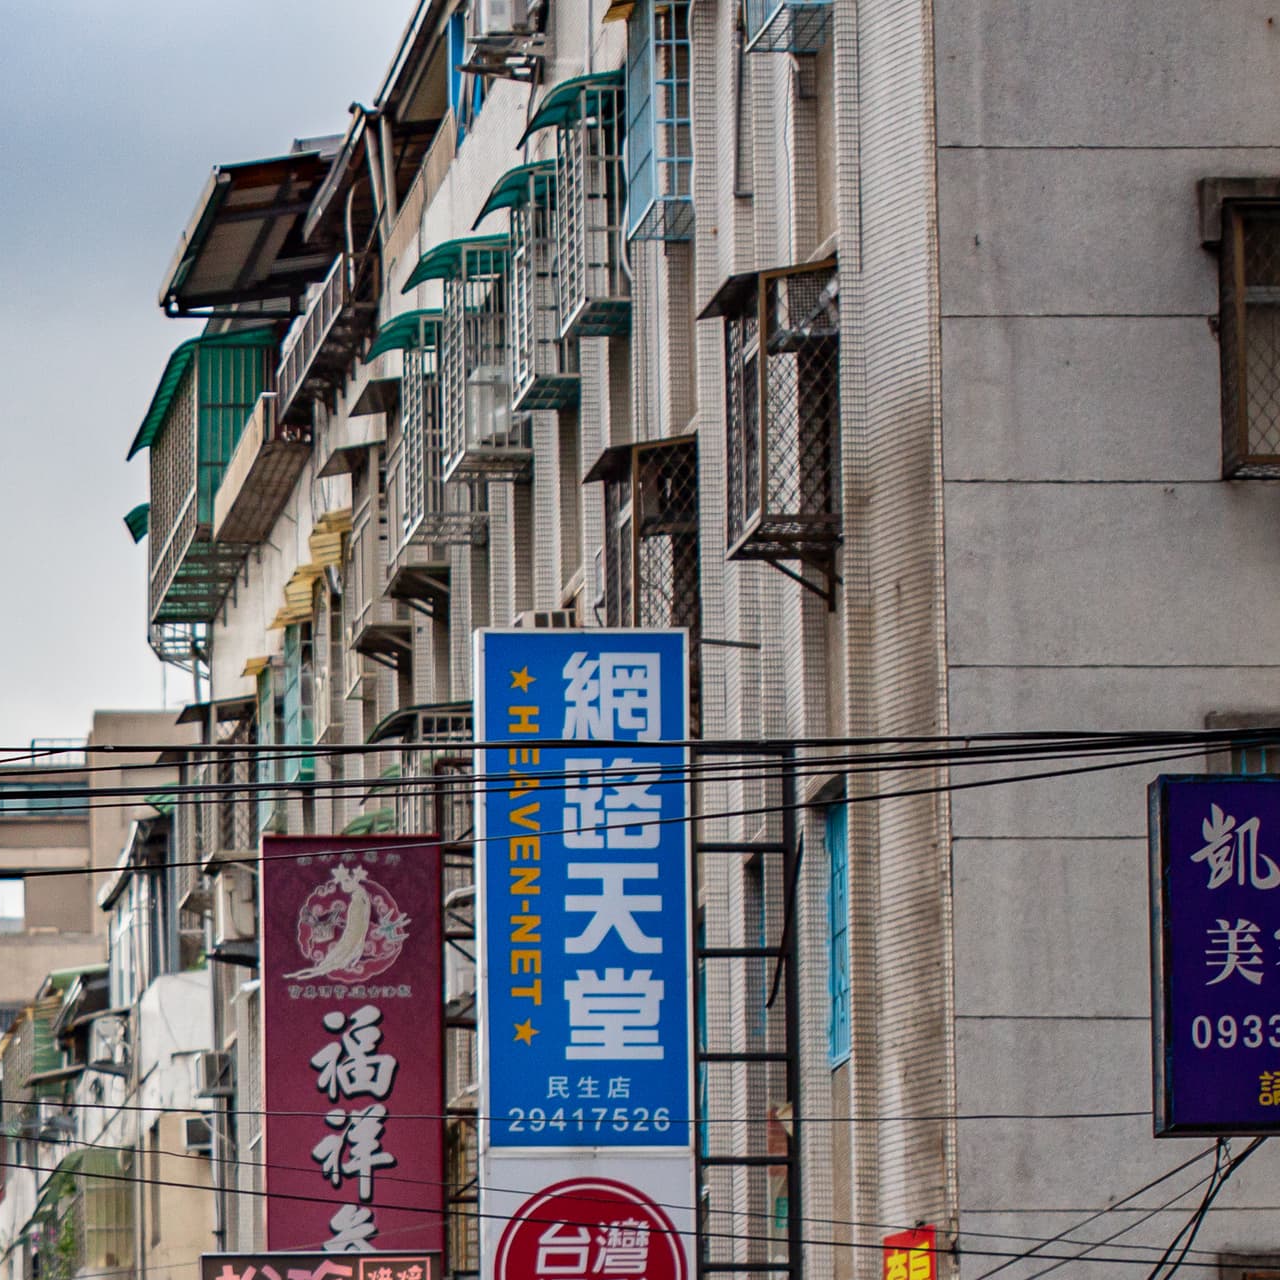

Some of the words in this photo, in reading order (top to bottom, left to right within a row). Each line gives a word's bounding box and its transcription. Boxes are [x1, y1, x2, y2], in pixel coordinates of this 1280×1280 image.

[508, 705, 542, 1005] HEAVEN-NET
[562, 650, 665, 1061] 網路天堂
[547, 1076, 632, 1099] 民生店
[508, 1107, 671, 1132] 29417526
[534, 1220, 651, 1276] 台灣
